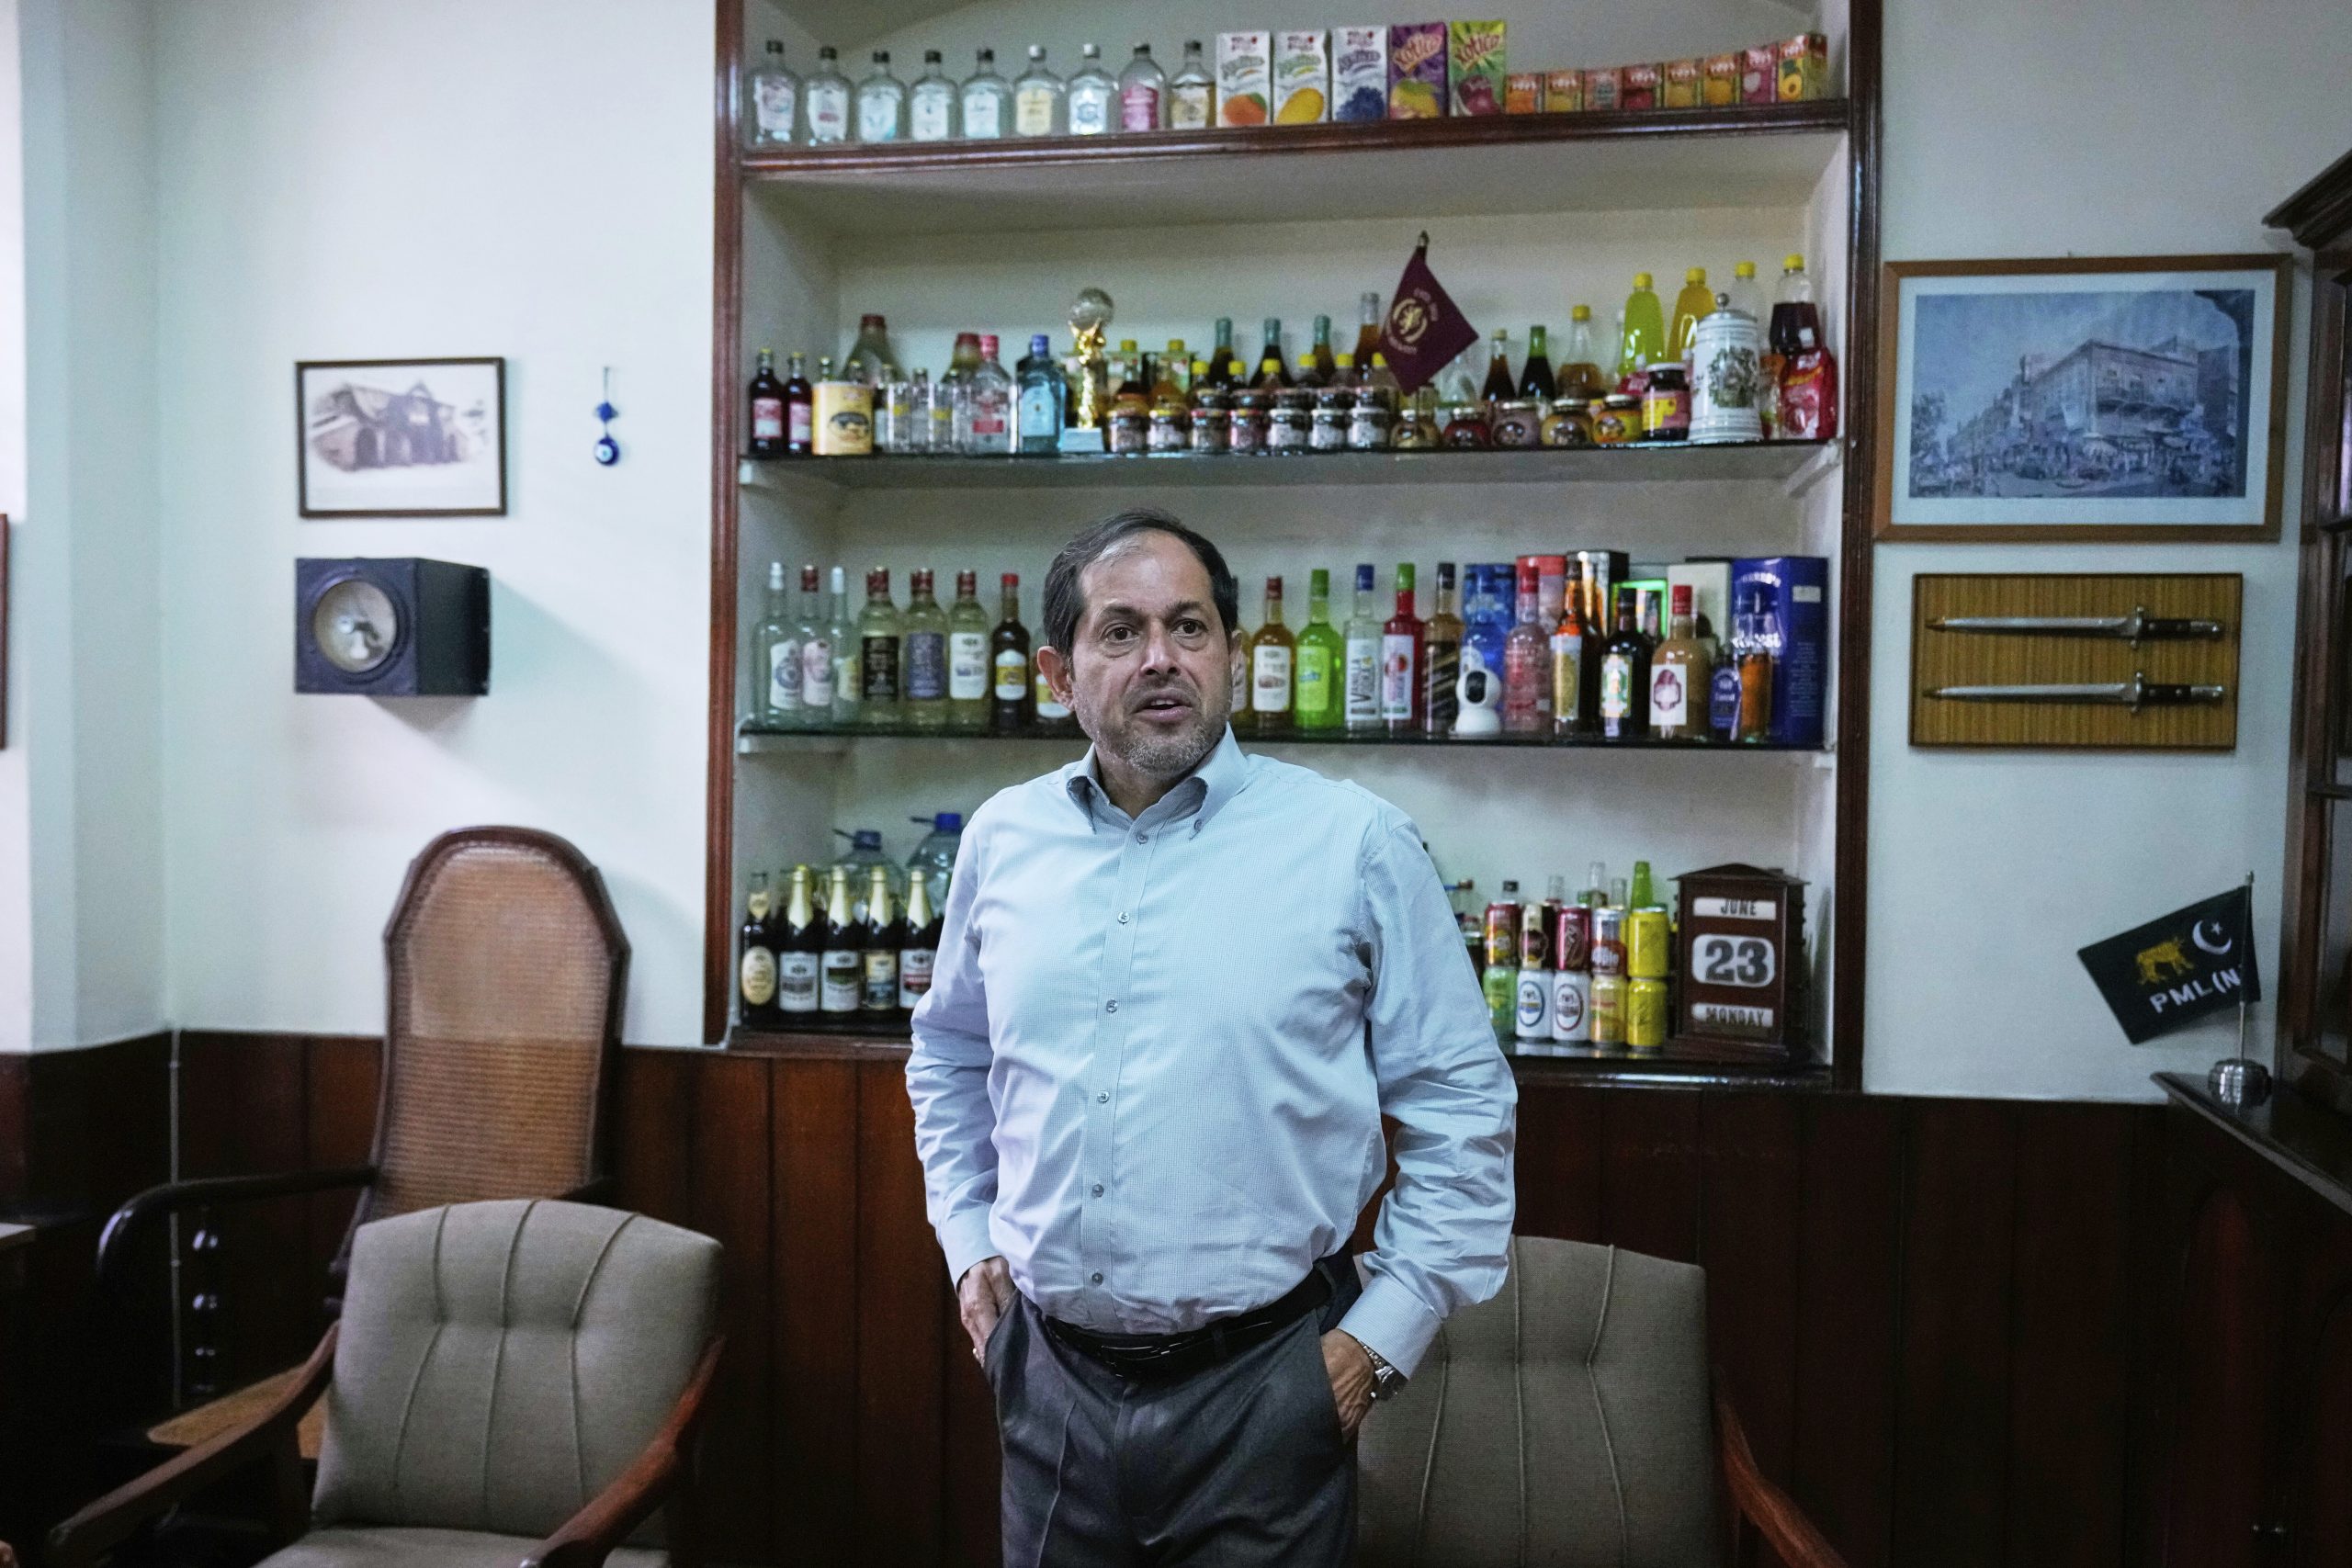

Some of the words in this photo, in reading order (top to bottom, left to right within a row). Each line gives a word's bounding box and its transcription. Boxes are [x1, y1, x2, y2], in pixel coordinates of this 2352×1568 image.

[1720, 898, 1758, 917] JUNE
[1705, 939, 1769, 984] 23
[1705, 1007, 1765, 1027] MONDAY
